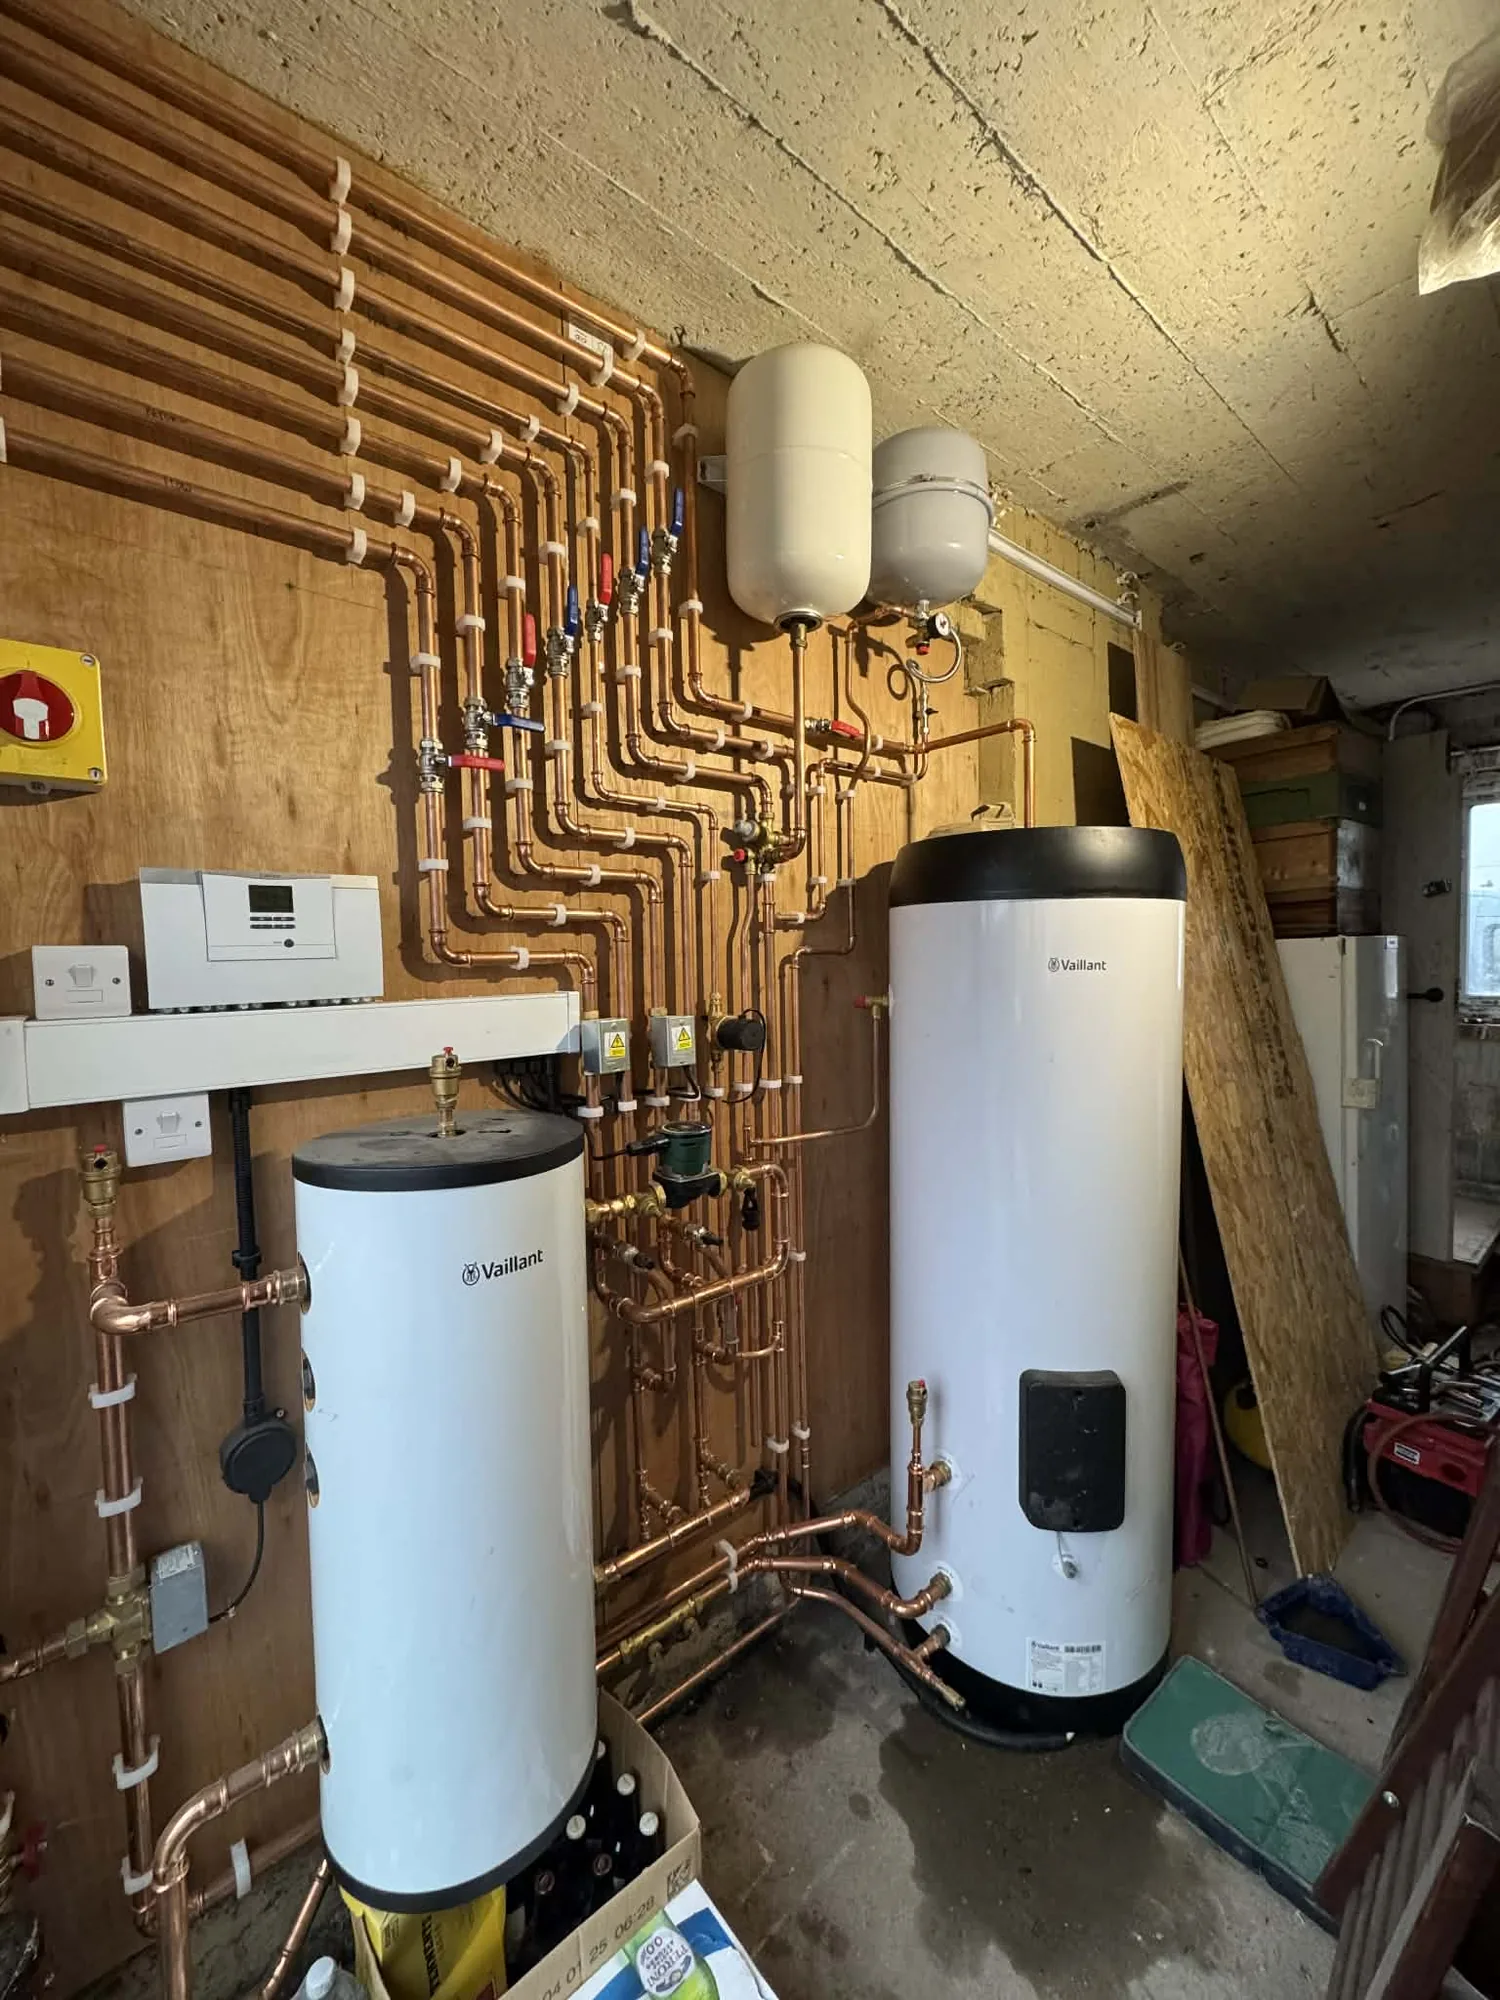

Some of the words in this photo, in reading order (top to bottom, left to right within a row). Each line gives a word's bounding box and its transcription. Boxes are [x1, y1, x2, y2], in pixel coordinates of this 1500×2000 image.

[1061, 958, 1107, 971] Vaillant
[481, 1249, 544, 1280] Vaillant
[588, 1939, 608, 1964] 25
